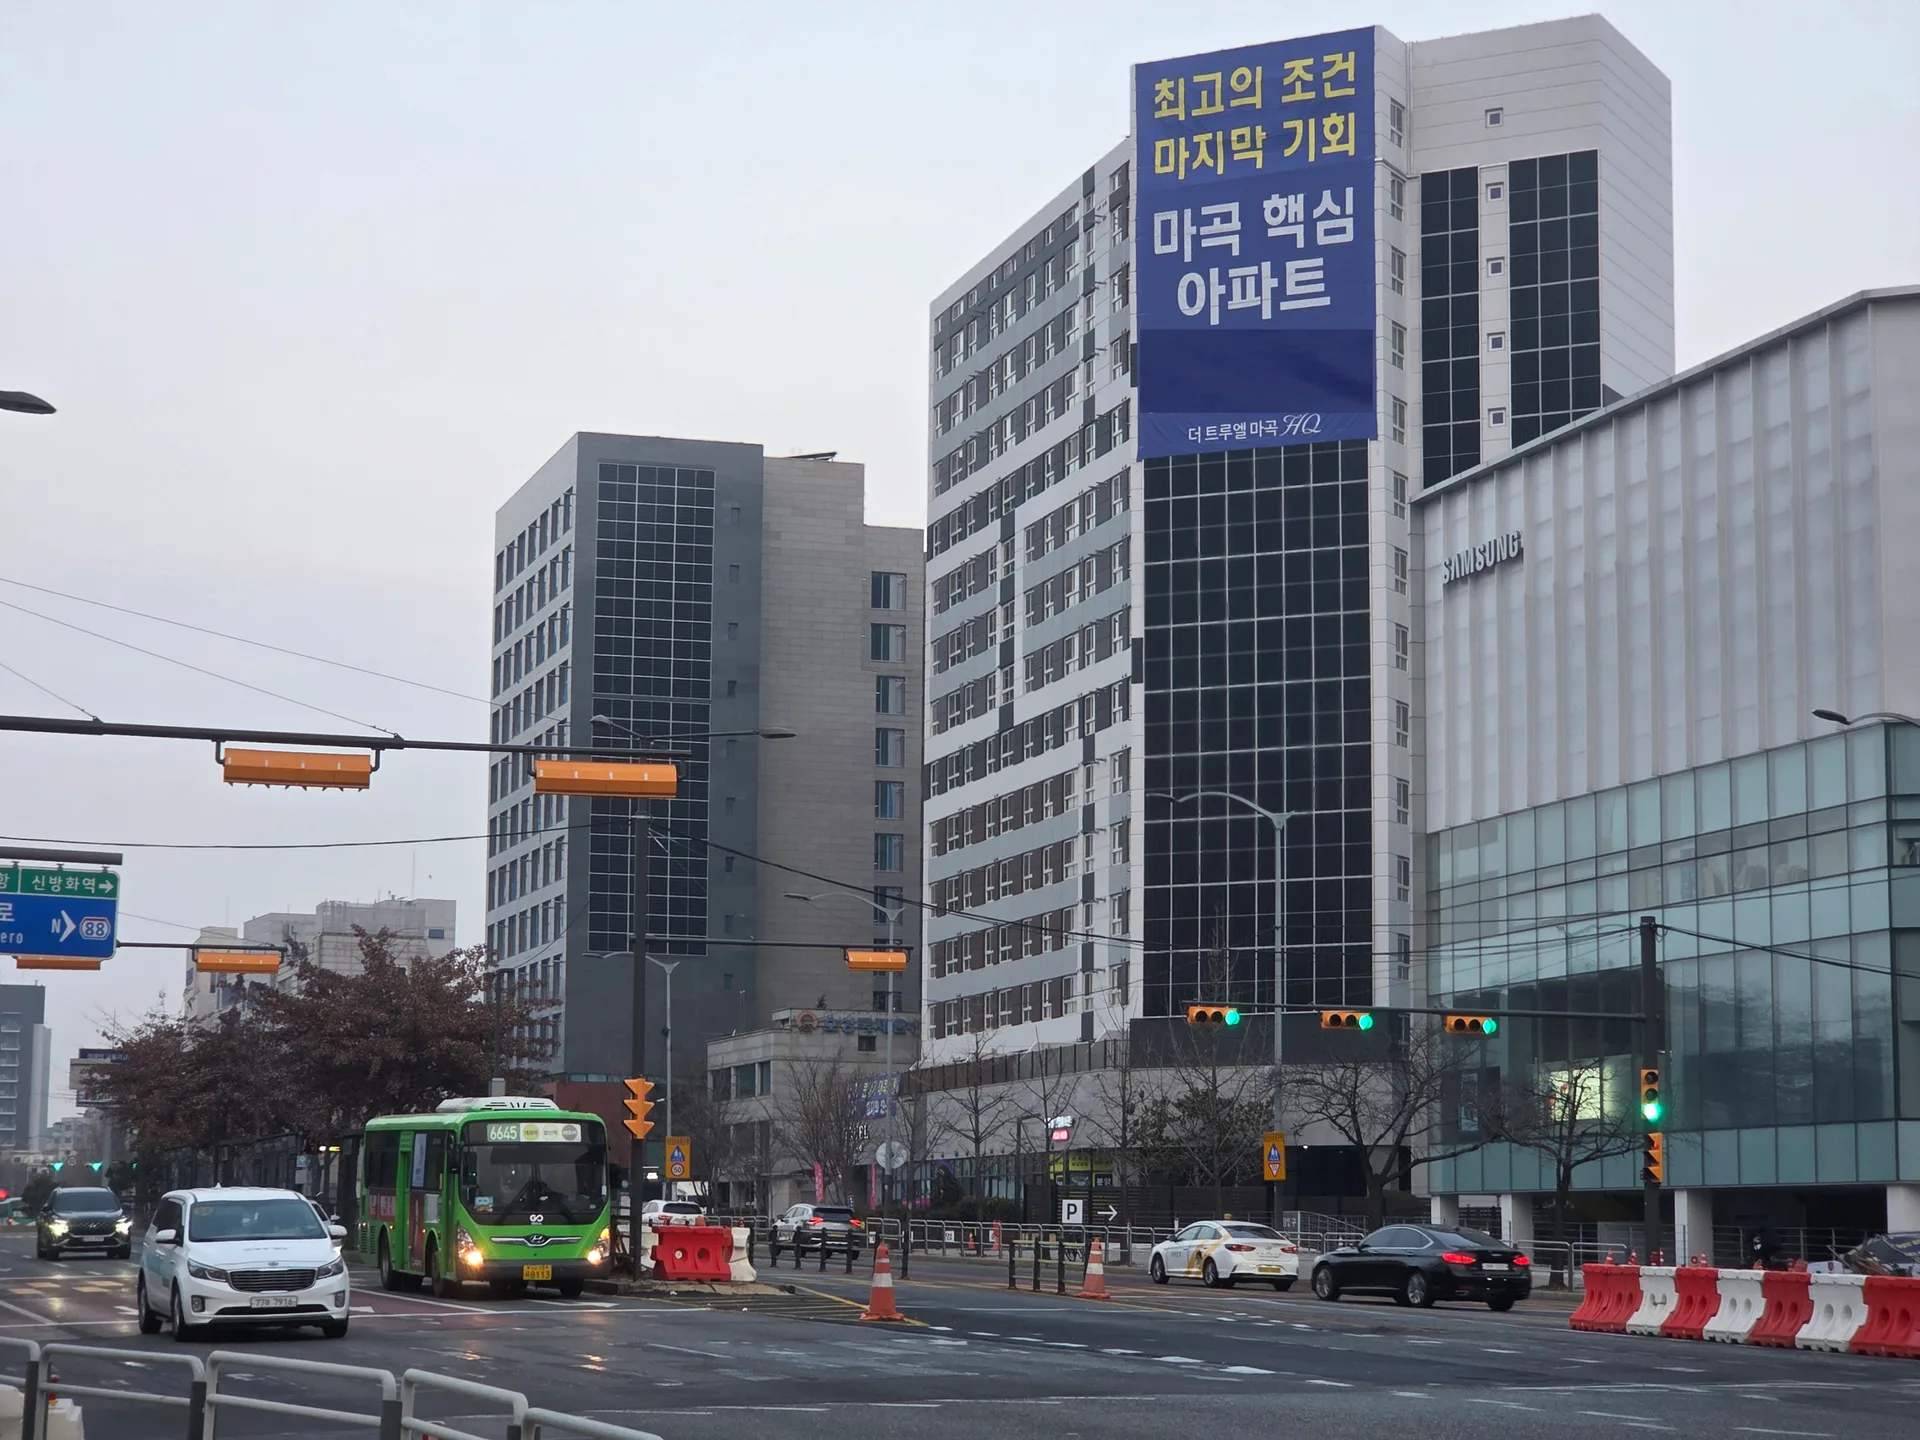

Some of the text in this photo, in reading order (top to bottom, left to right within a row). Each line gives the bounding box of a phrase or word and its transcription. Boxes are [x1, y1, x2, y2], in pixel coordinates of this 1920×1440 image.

[1154, 51, 1356, 121] 최고의 조건
[1154, 112, 1356, 180] 마지막 기회
[1154, 186, 1354, 262] 마곡 핵심
[1177, 257, 1331, 326] 아파트
[1188, 412, 1323, 444] 더 트루엘 마곡 HQ
[1442, 531, 1520, 585] SAMSUNG
[32, 875, 96, 894] 신방화역
[84, 921, 105, 937] 88
[490, 1126, 517, 1140] 6645
[1067, 1203, 1077, 1220] P
